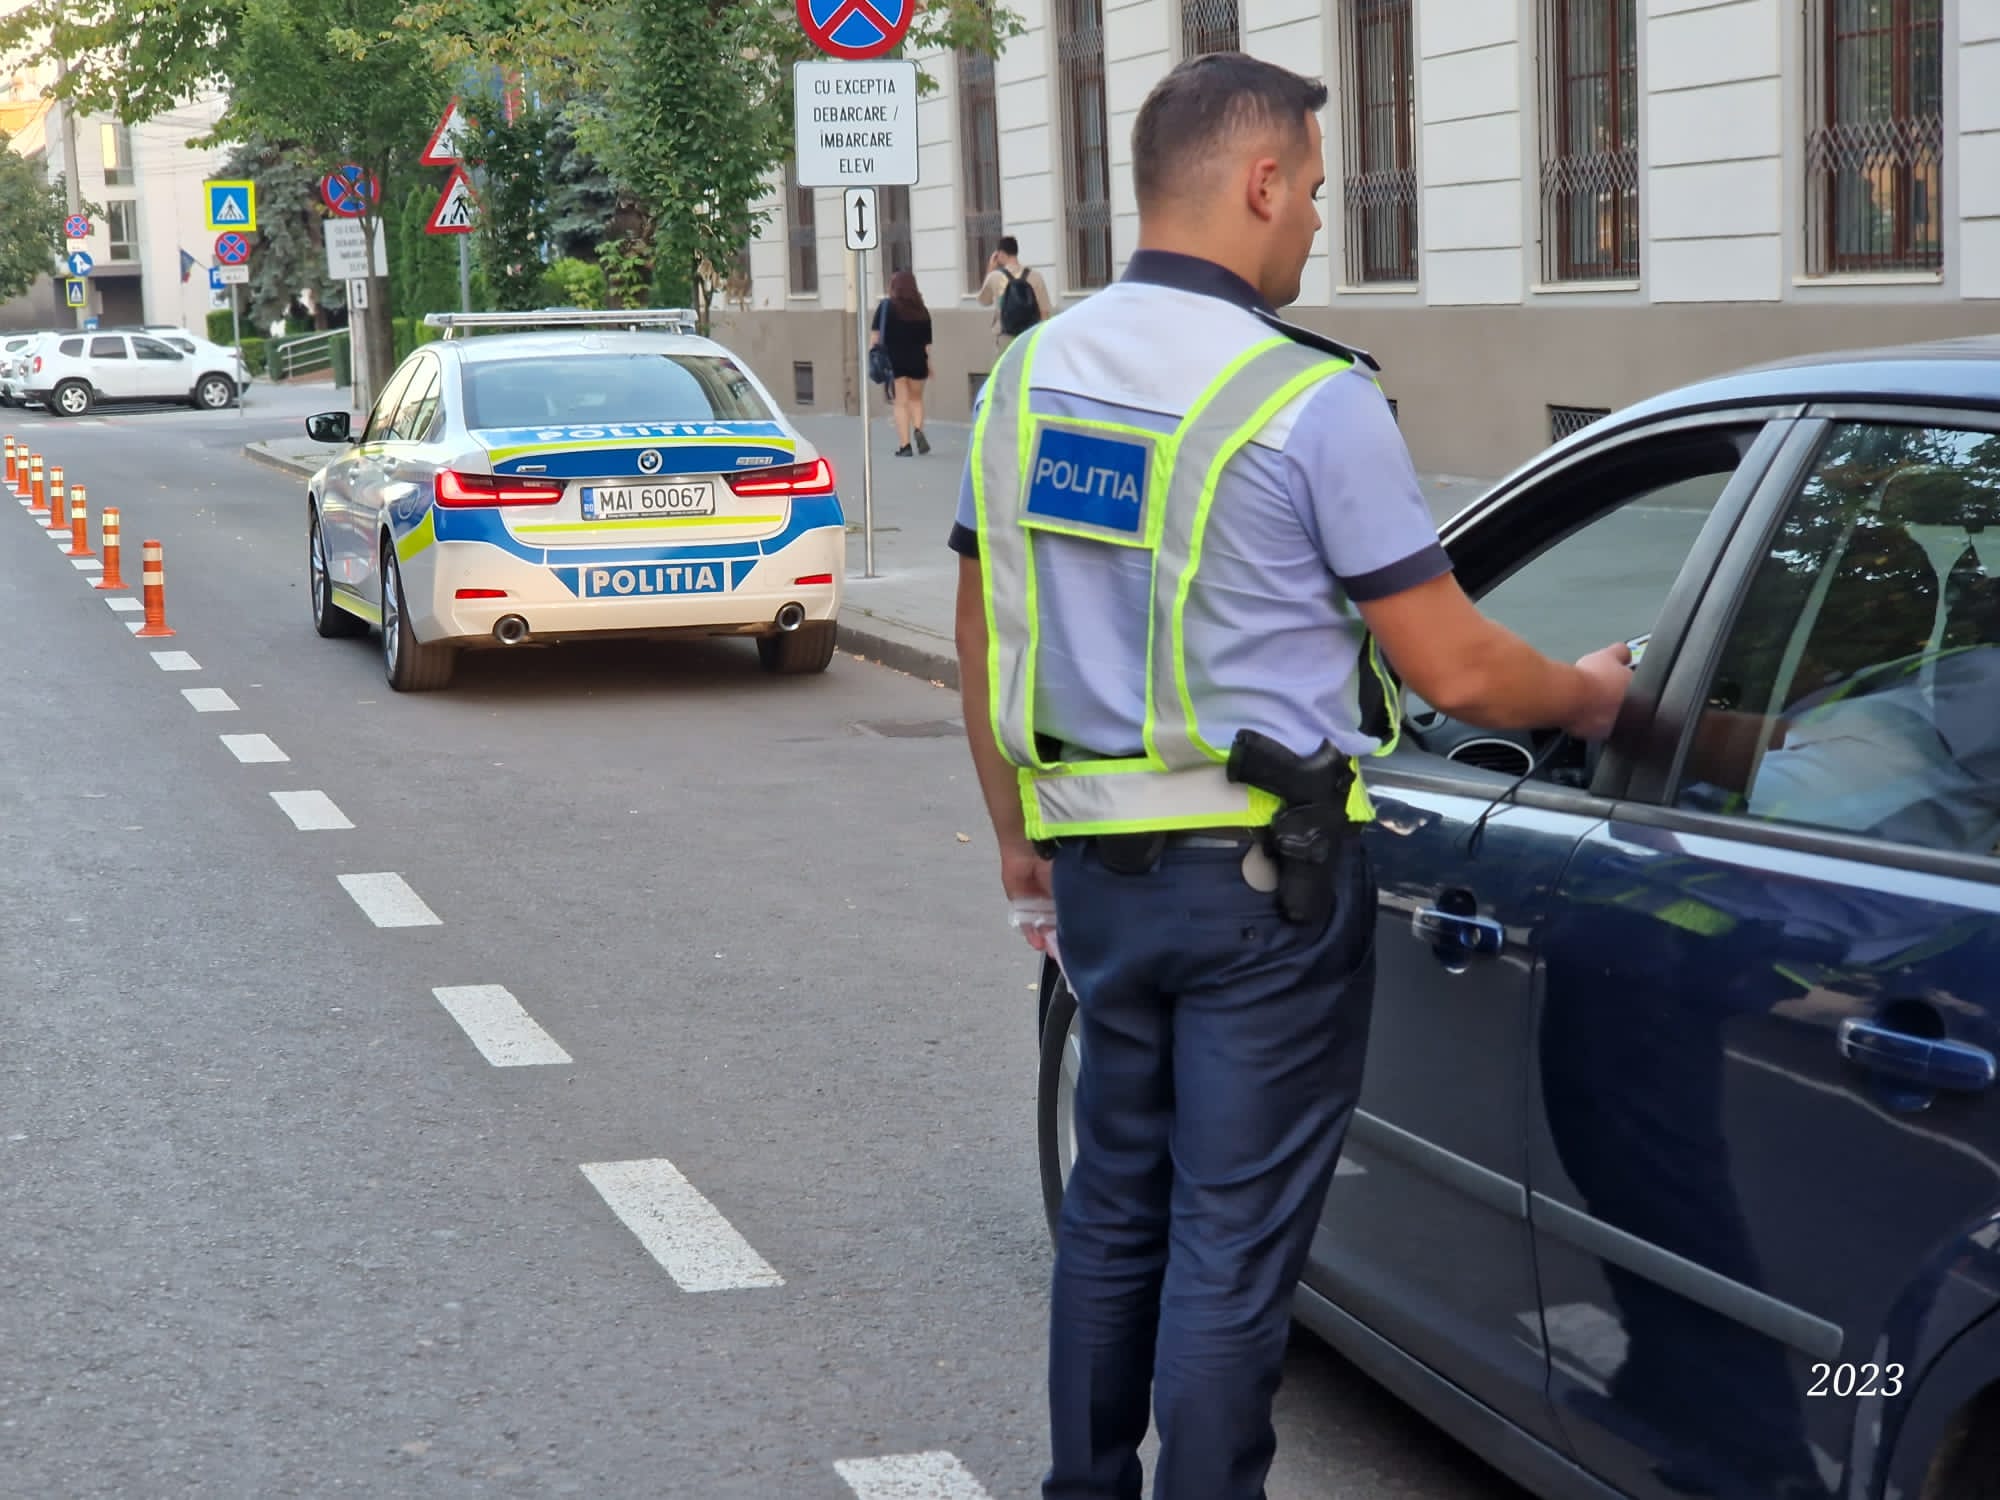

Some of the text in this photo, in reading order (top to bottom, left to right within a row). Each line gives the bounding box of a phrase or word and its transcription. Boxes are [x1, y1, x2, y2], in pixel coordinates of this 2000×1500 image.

[814, 79, 896, 95] CU EXCEPTIA
[813, 105, 899, 123] DEBARCARE /
[839, 157, 874, 174] ELEVI
[536, 424, 735, 441] POLITIA
[1035, 456, 1140, 504] POLITIA
[600, 487, 706, 512] MAI 60067
[592, 565, 718, 595] POLITIA
